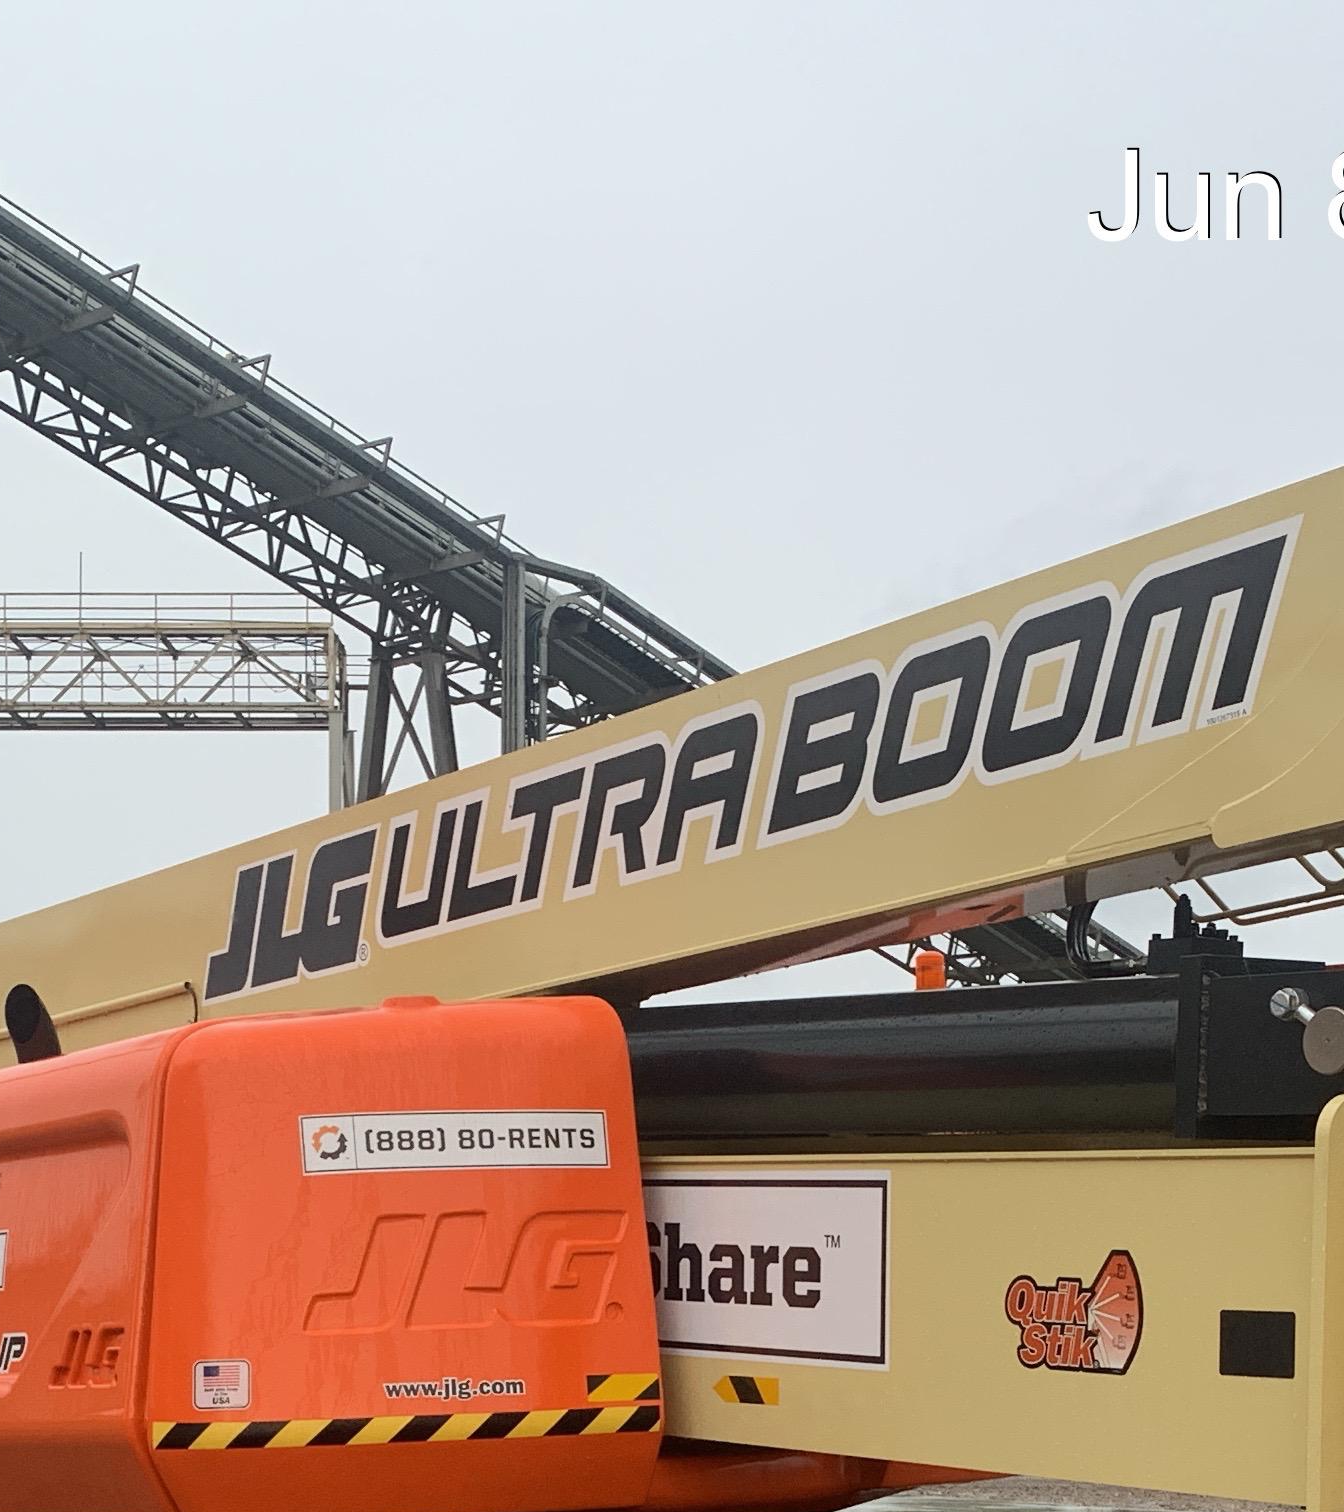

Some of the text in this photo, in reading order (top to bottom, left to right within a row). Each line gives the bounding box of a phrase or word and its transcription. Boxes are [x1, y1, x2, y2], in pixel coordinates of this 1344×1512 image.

[204, 532, 1289, 1001] JLG ULTRA BOOM
[364, 1127, 597, 1154] (888) 80-RENTS
[302, 1208, 628, 1337] JLG
[1006, 1278, 1093, 1329] Quik
[1018, 1322, 1097, 1369] Stik
[212, 1396, 230, 1405] USA
[384, 1378, 525, 1400] www.jlg.com
